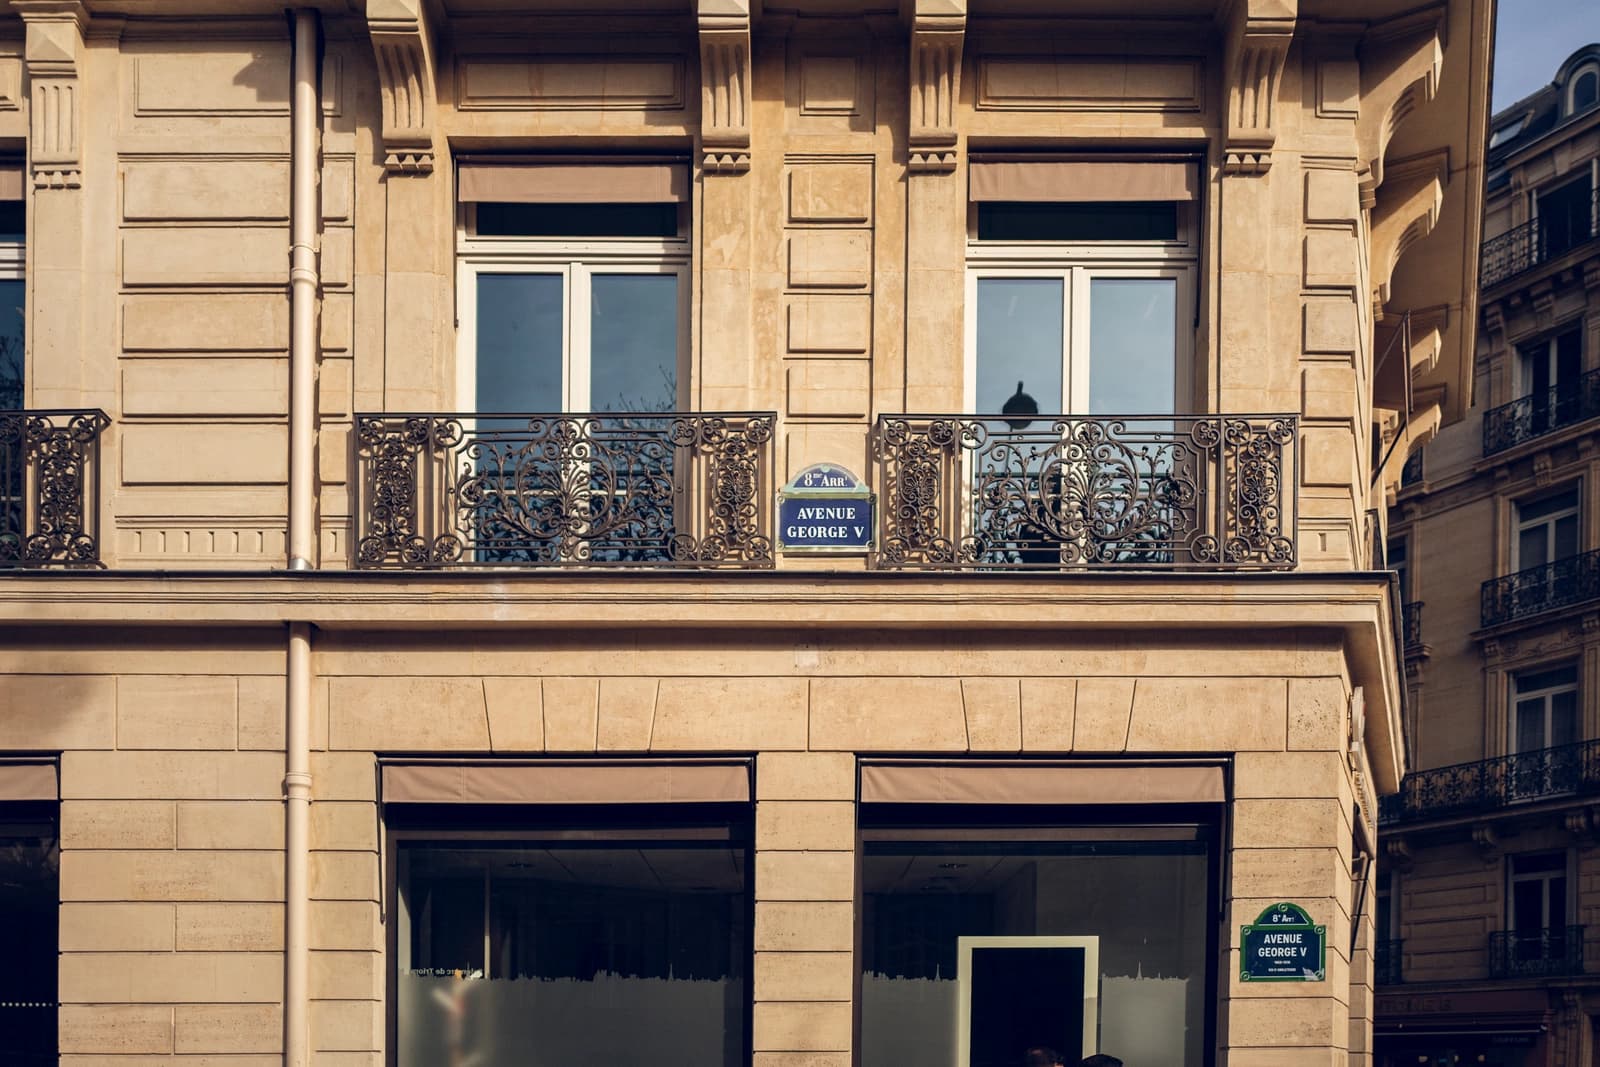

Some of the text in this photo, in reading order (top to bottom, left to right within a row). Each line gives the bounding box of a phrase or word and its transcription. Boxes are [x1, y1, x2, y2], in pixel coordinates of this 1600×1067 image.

[797, 507, 856, 520] AVENUE
[786, 525, 865, 539] GEORGE V
[1263, 934, 1303, 944] AVENUE
[1258, 947, 1307, 957] GEORGE V
